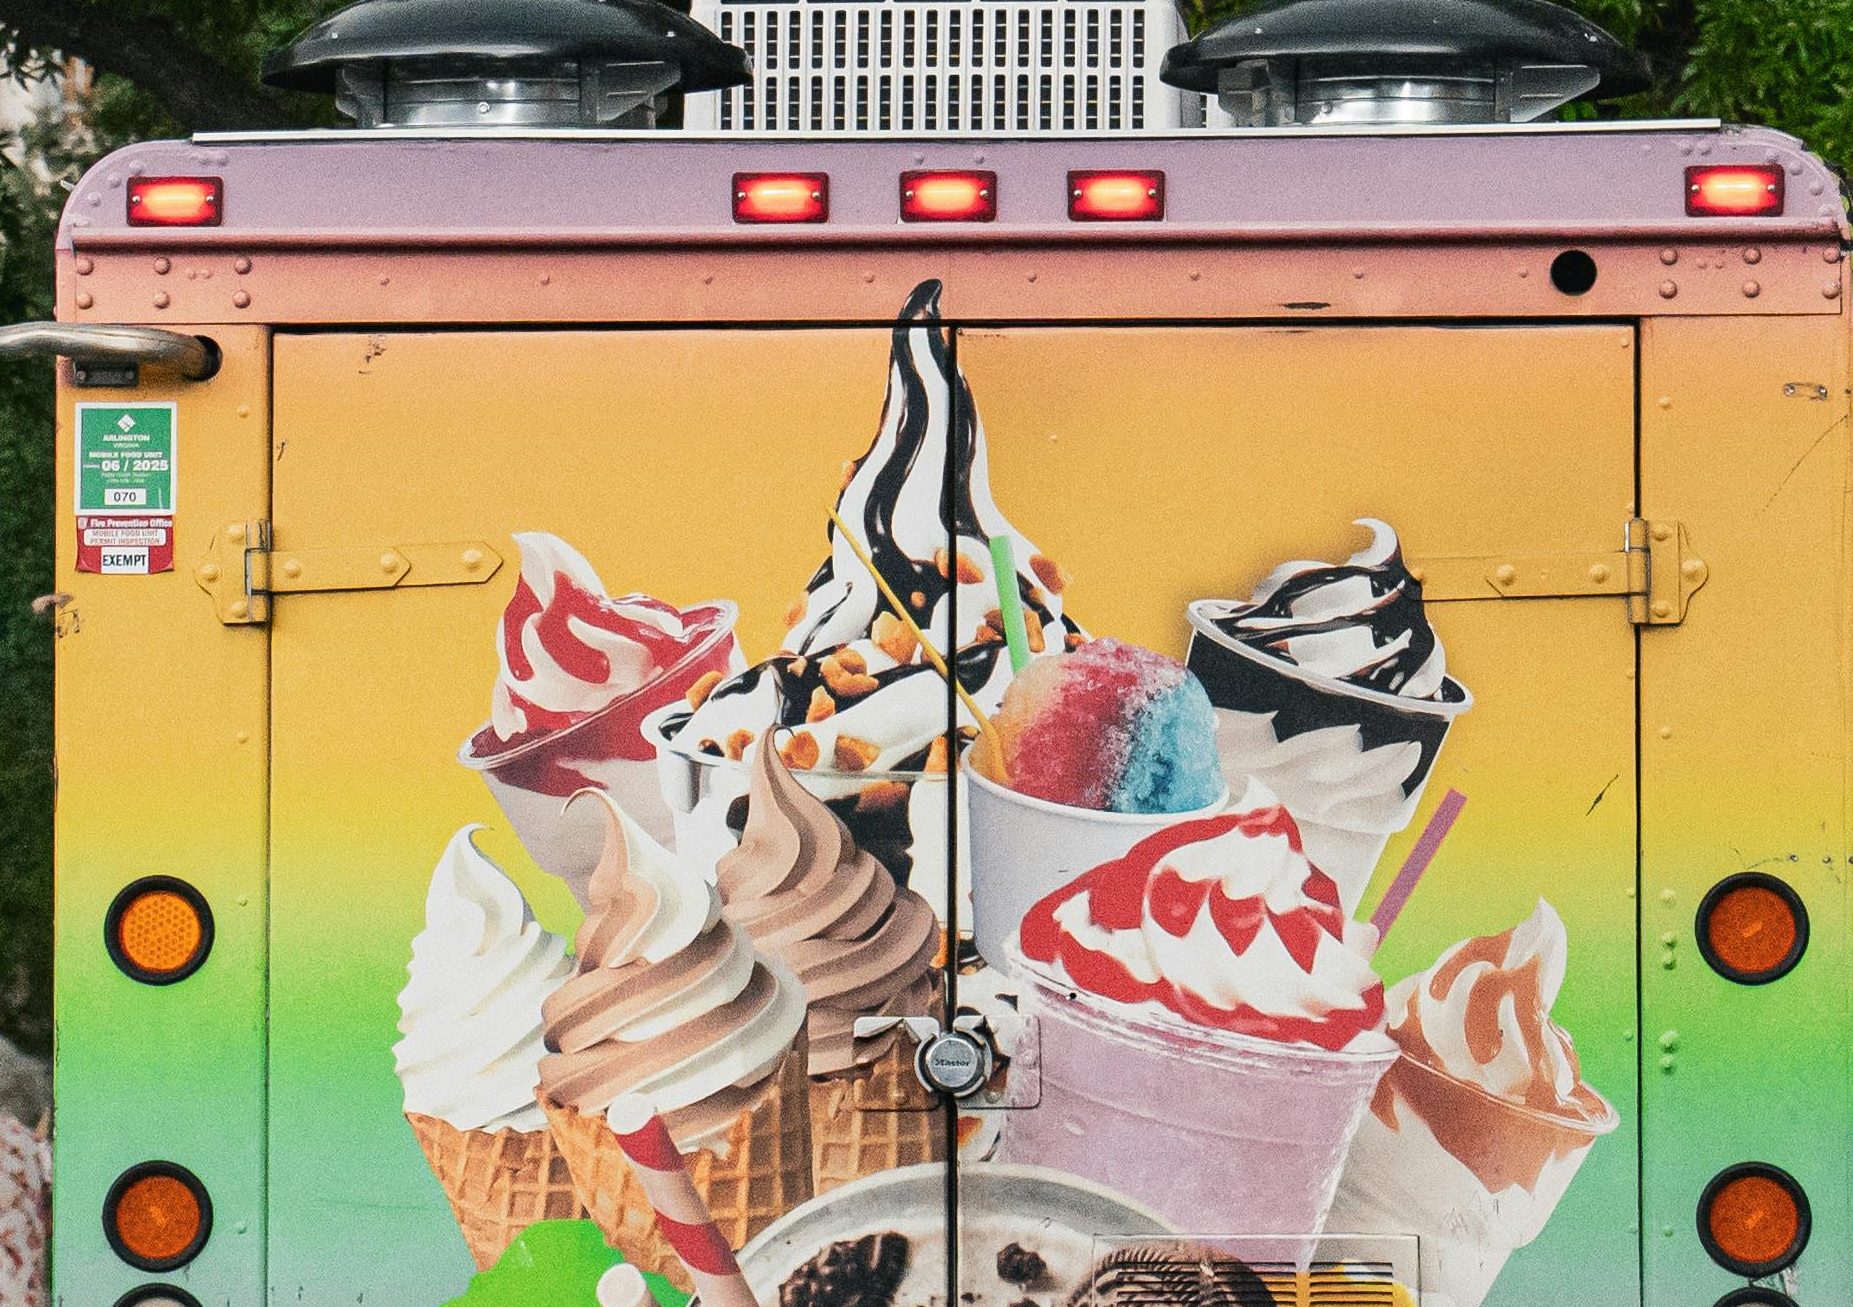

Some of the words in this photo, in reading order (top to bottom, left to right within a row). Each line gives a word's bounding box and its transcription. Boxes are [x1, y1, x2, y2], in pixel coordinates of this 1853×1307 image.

[102, 434, 150, 442] ARLINGTON
[132, 460, 168, 471] 2025
[113, 491, 137, 503] 070
[90, 518, 106, 527] Fire
[107, 518, 148, 527] Prevention
[149, 517, 173, 527] Office
[102, 554, 146, 566] EXEMPT
